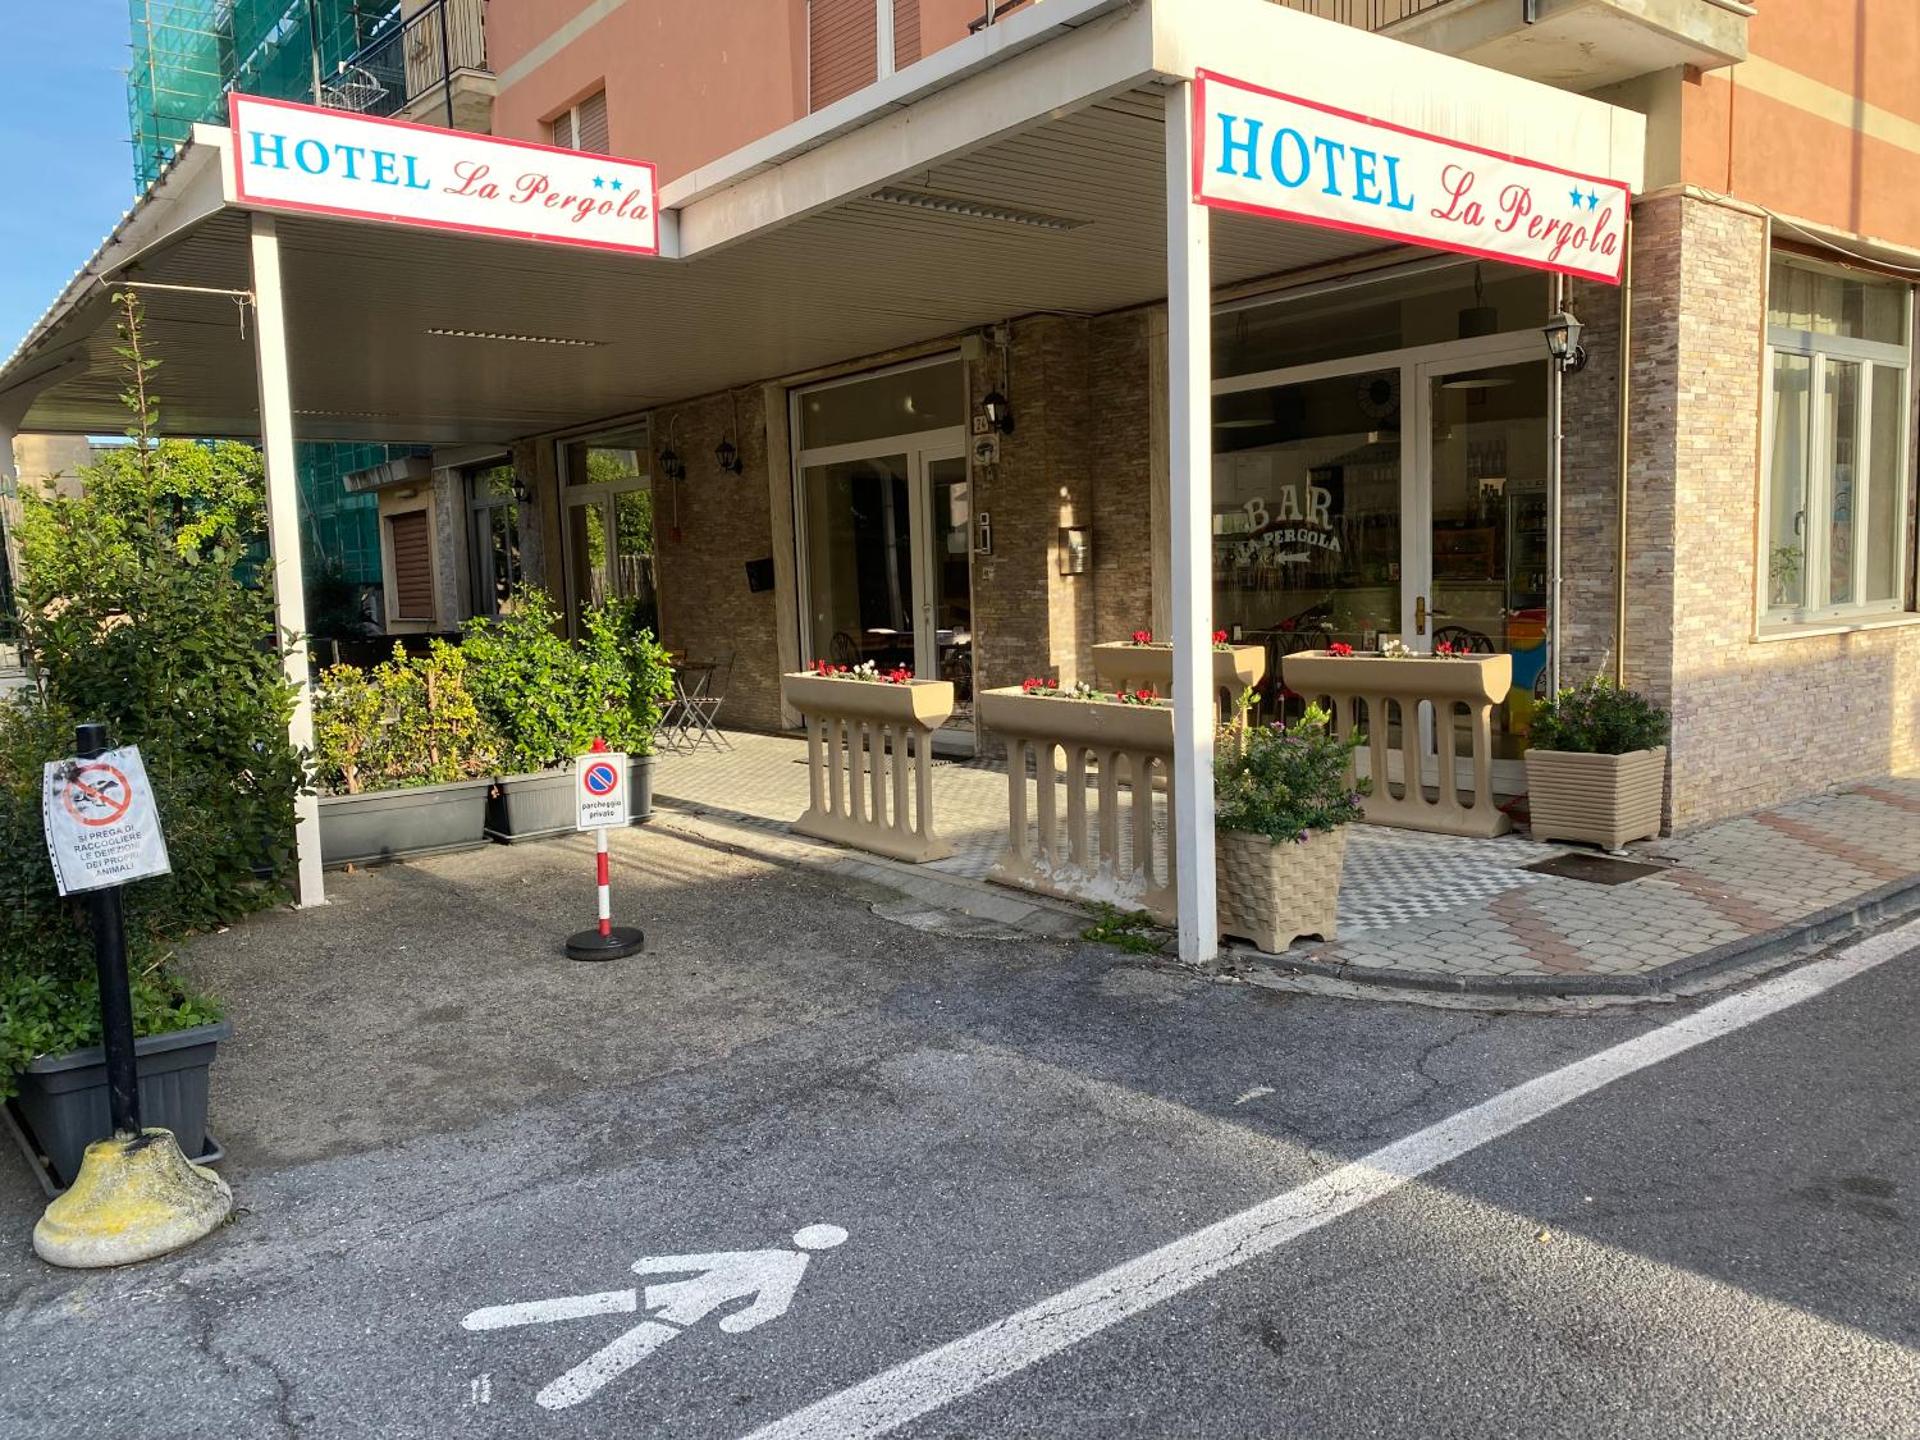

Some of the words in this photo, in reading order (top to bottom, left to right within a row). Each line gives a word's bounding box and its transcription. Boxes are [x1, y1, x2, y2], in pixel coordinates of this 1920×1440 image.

[248, 131, 431, 190] HOTEL
[444, 160, 501, 199] La
[509, 172, 650, 223] Pergola
[1216, 112, 1415, 212] HOTEL
[1430, 164, 1485, 227] La
[1494, 184, 1618, 261] Pergola
[1244, 484, 1333, 533] BAR
[1263, 528, 1341, 552] PERGOLA
[582, 800, 622, 810] parcheggio
[589, 810, 615, 819] privato
[74, 832, 142, 853] RACCOGLIERE
[78, 834, 87, 843] SI
[89, 828, 124, 839] PREGA
[125, 824, 134, 832] DI
[80, 852, 92, 861] LE
[86, 860, 102, 869] DEI
[97, 863, 134, 875] ANIMALI
